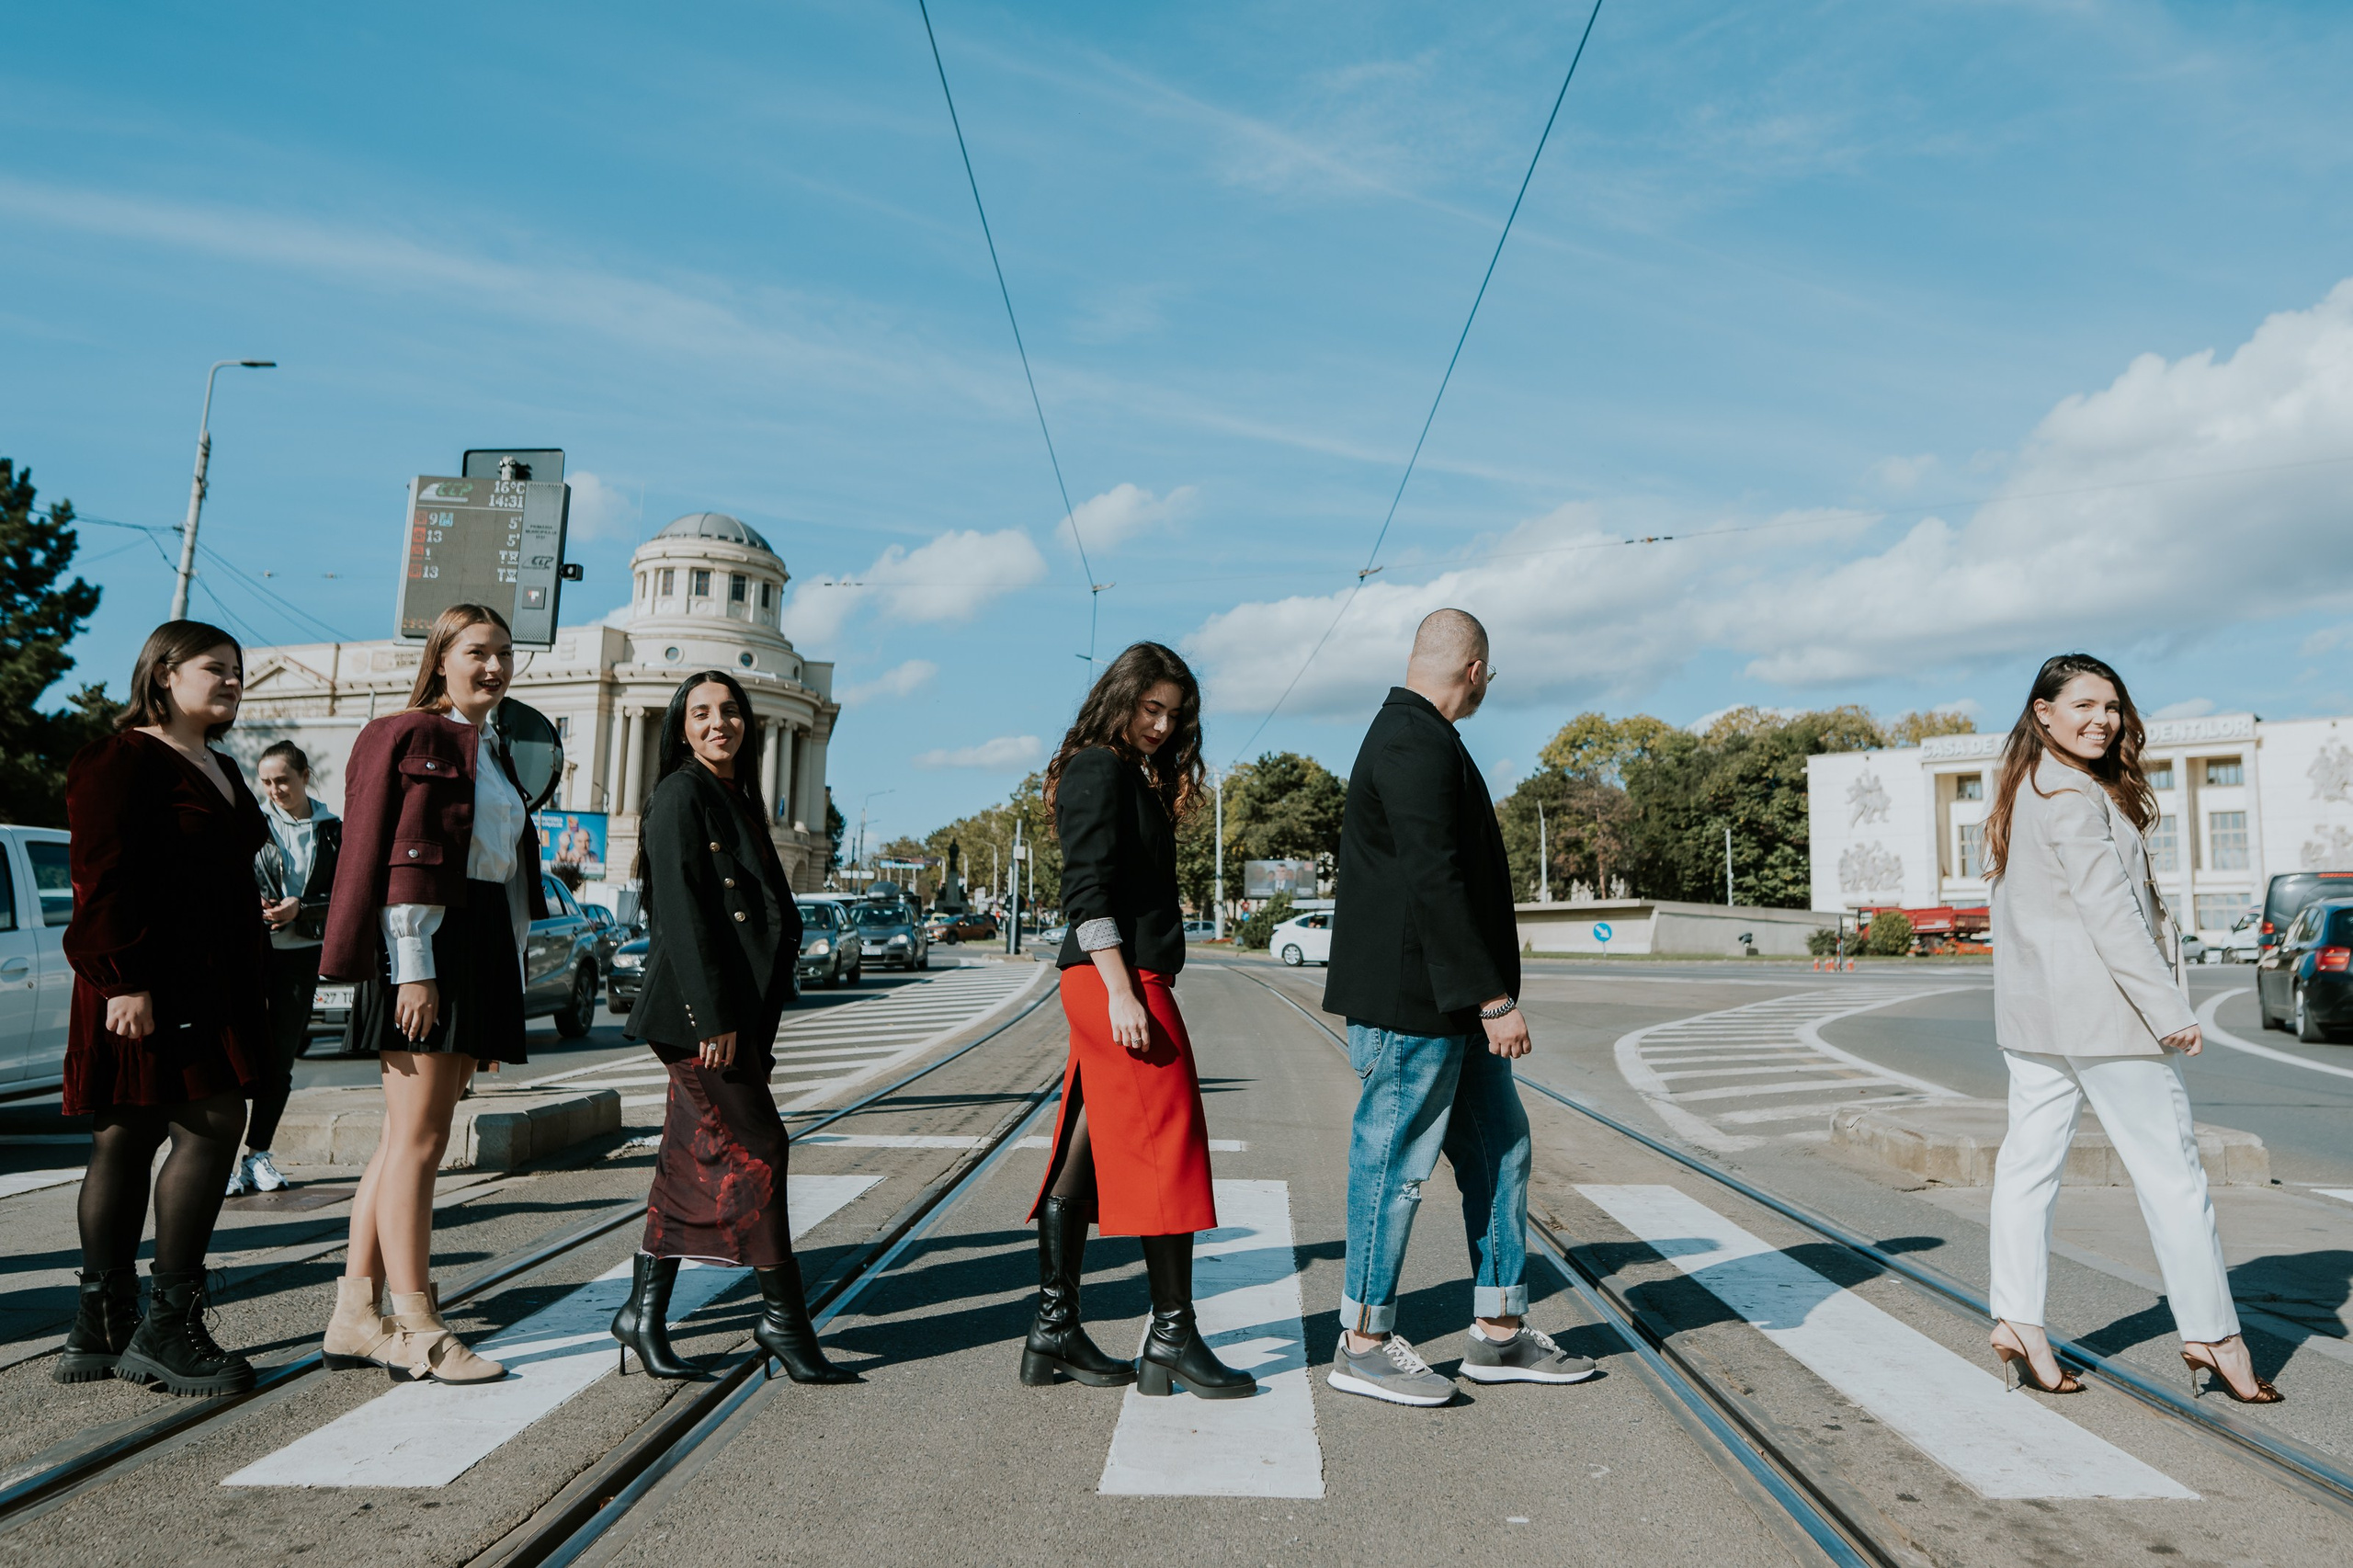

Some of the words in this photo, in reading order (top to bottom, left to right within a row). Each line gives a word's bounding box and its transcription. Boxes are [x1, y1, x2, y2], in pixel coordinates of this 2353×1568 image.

[494, 480, 526, 494] 16°C
[489, 494, 524, 508] 14:31
[426, 529, 442, 543] 13
[1922, 738, 1966, 758] CASA
[1971, 736, 1994, 756] DE
[2145, 716, 2250, 743] DENTILOR
[324, 992, 336, 1005] 27
